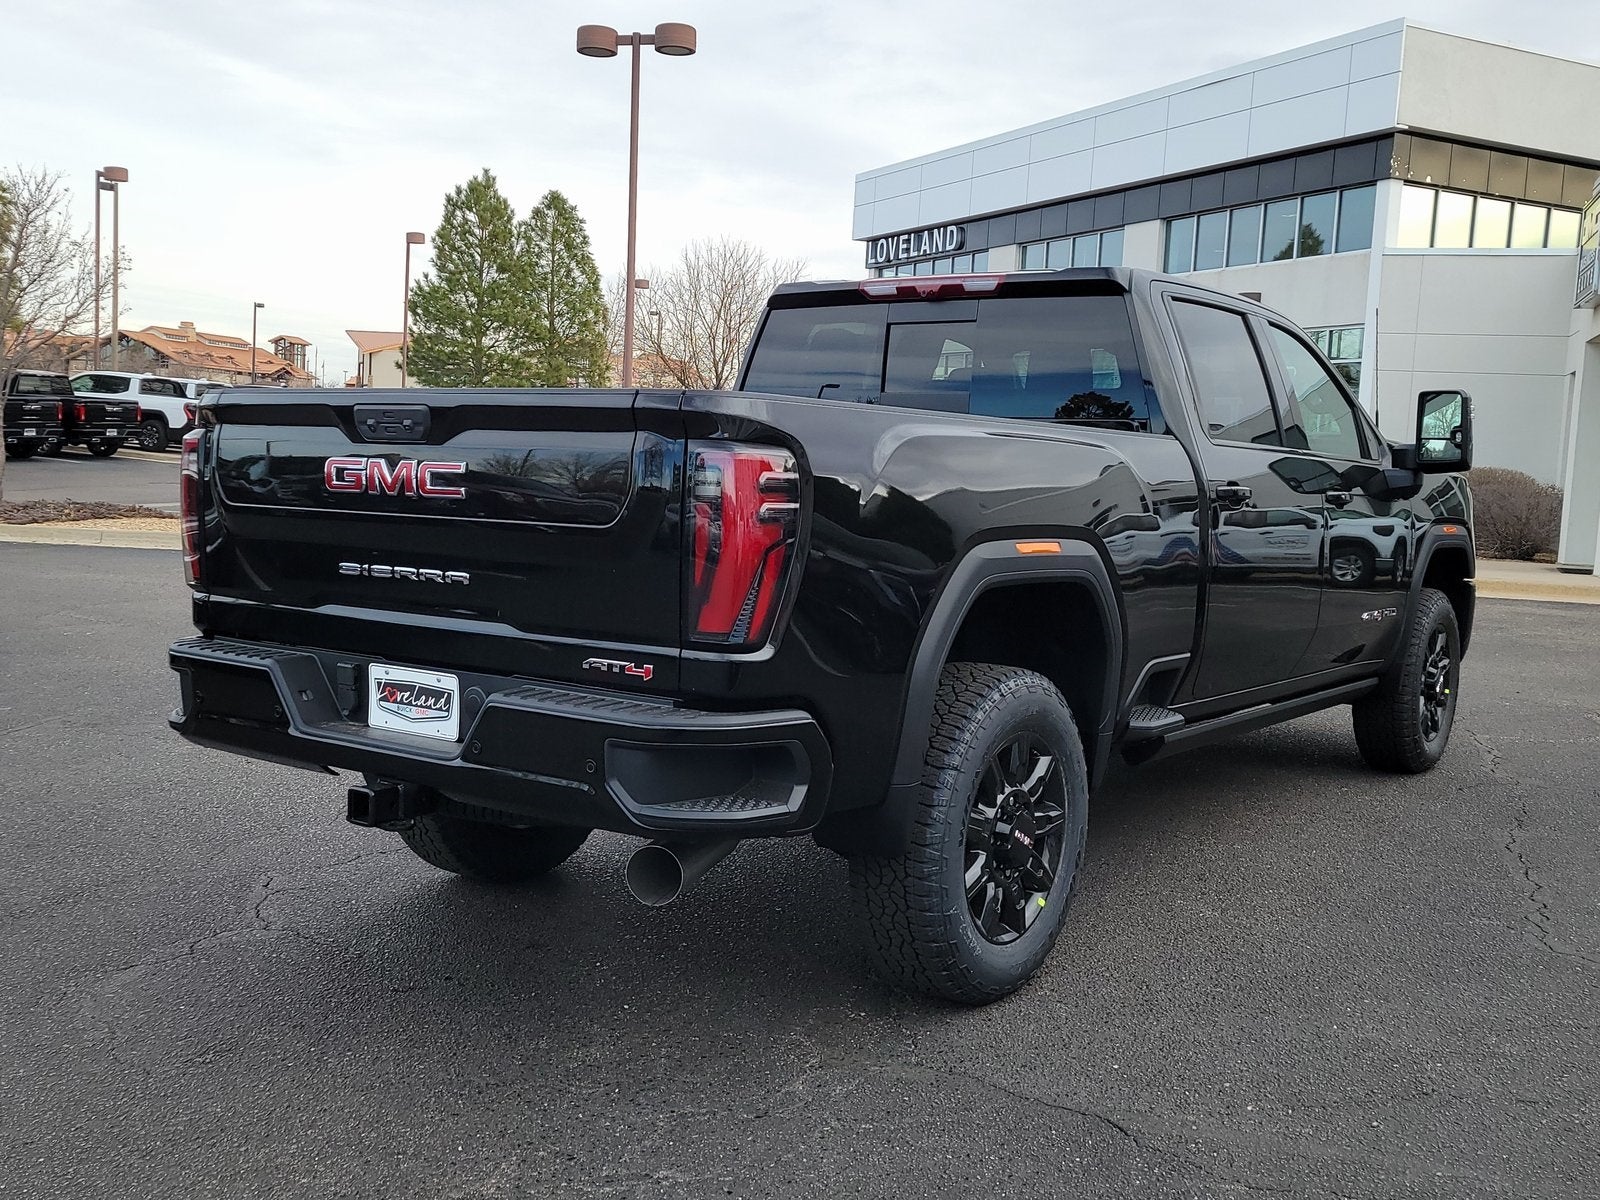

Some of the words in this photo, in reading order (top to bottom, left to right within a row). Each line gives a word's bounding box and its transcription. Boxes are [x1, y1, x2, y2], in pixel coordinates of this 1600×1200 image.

[868, 225, 958, 264] LOVELAND
[324, 457, 468, 499] GMC
[339, 562, 469, 585] SIERRA
[582, 658, 653, 681] AT4
